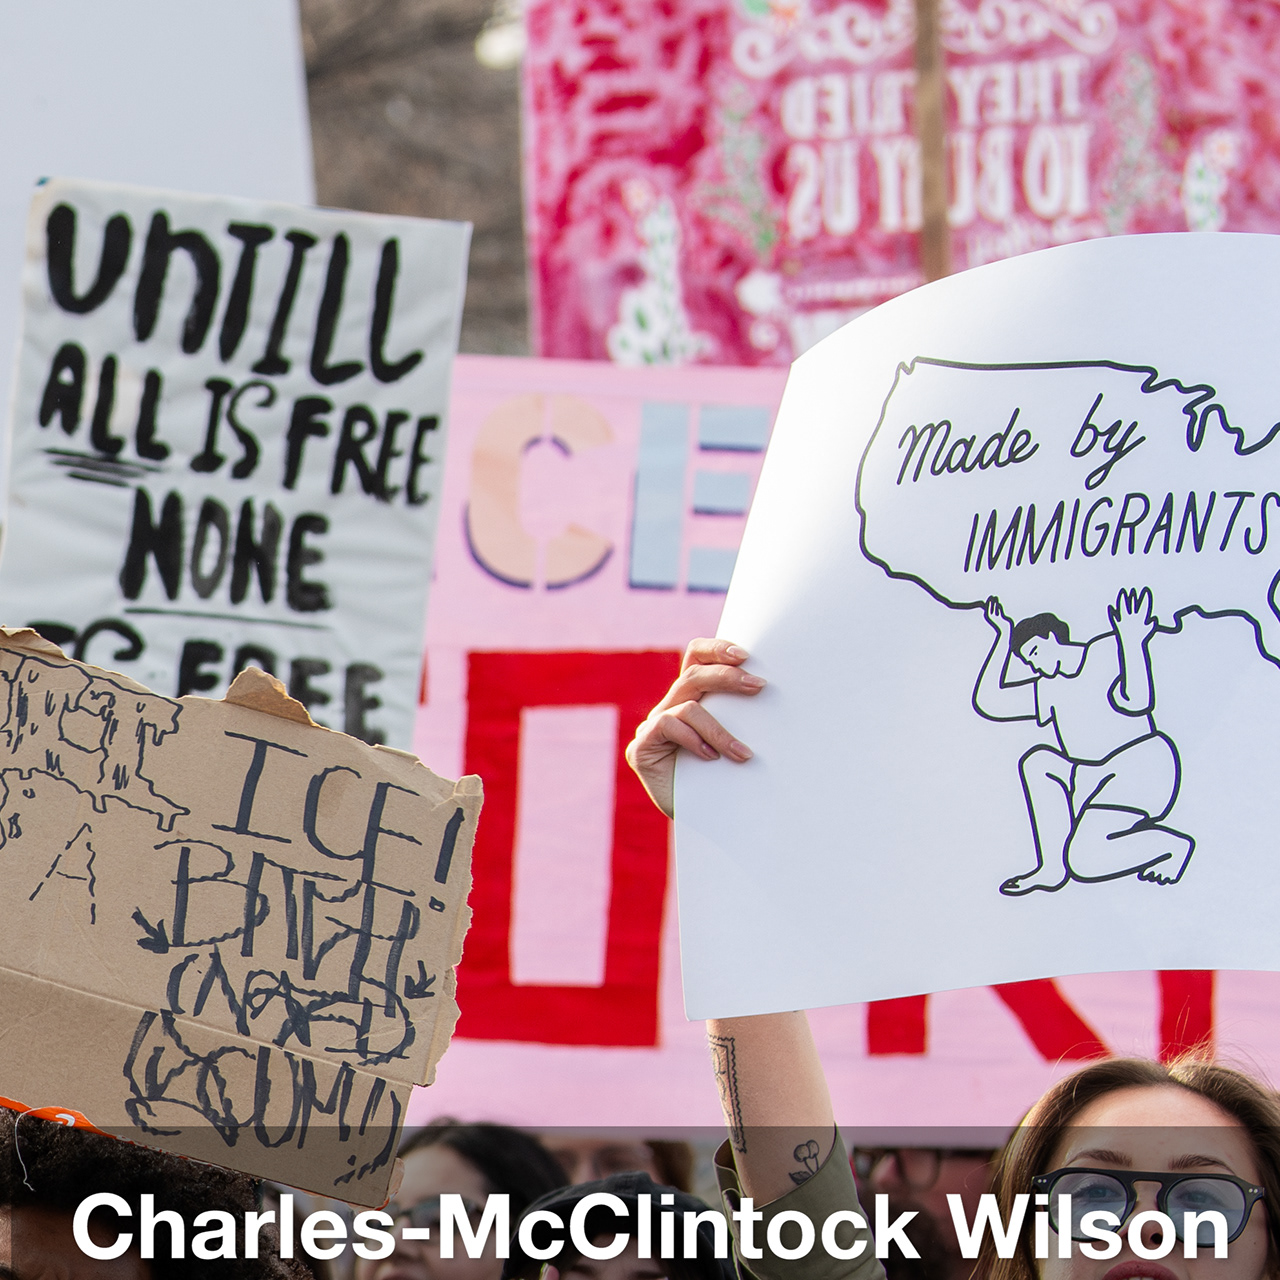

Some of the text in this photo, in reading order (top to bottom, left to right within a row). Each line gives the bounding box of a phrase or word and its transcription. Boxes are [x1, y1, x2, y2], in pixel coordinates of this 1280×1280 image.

[38, 341, 439, 507] ALL IS FREE
[897, 391, 1147, 491] Made by
[117, 484, 335, 613] NONE
[963, 489, 1280, 575] IMMIGRANTS
[211, 731, 466, 914] ICE!
